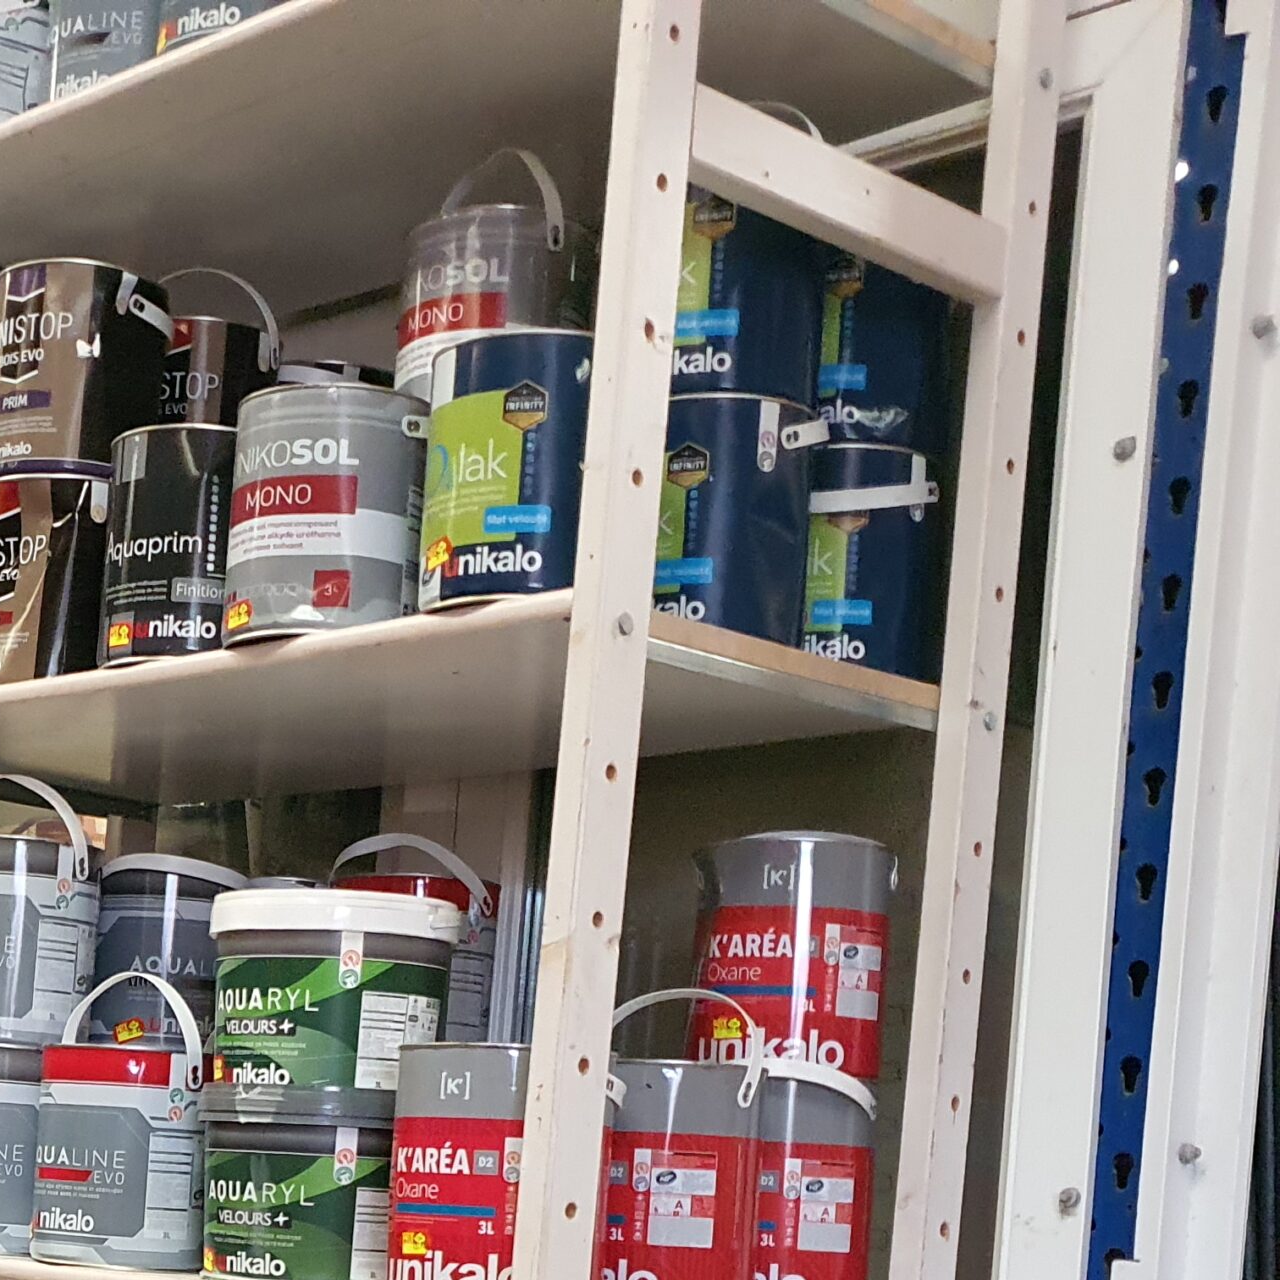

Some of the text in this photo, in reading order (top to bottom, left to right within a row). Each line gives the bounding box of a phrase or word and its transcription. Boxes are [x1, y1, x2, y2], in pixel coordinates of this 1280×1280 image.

[21, 348, 45, 363] EVO
[2, 394, 28, 410] PRIM
[236, 437, 360, 477] NIKOSOL
[245, 484, 312, 511] MONO
[107, 531, 202, 567] Aquaprim
[134, 614, 216, 639] unikalo
[709, 927, 793, 958] K'ARÉA
[708, 963, 761, 982] Oxane
[219, 988, 319, 1012] AQUARYL
[225, 1019, 277, 1035] VELOURS
[397, 1141, 470, 1176] K'ARÉA
[93, 1171, 125, 1185] EVO
[396, 1177, 439, 1199] Oxane
[208, 1180, 315, 1206] AQUARYL
[219, 1209, 272, 1226] VELOURS
[478, 1221, 495, 1235] 3L
[609, 1228, 625, 1242] 3L
[760, 1234, 775, 1247] 3L
